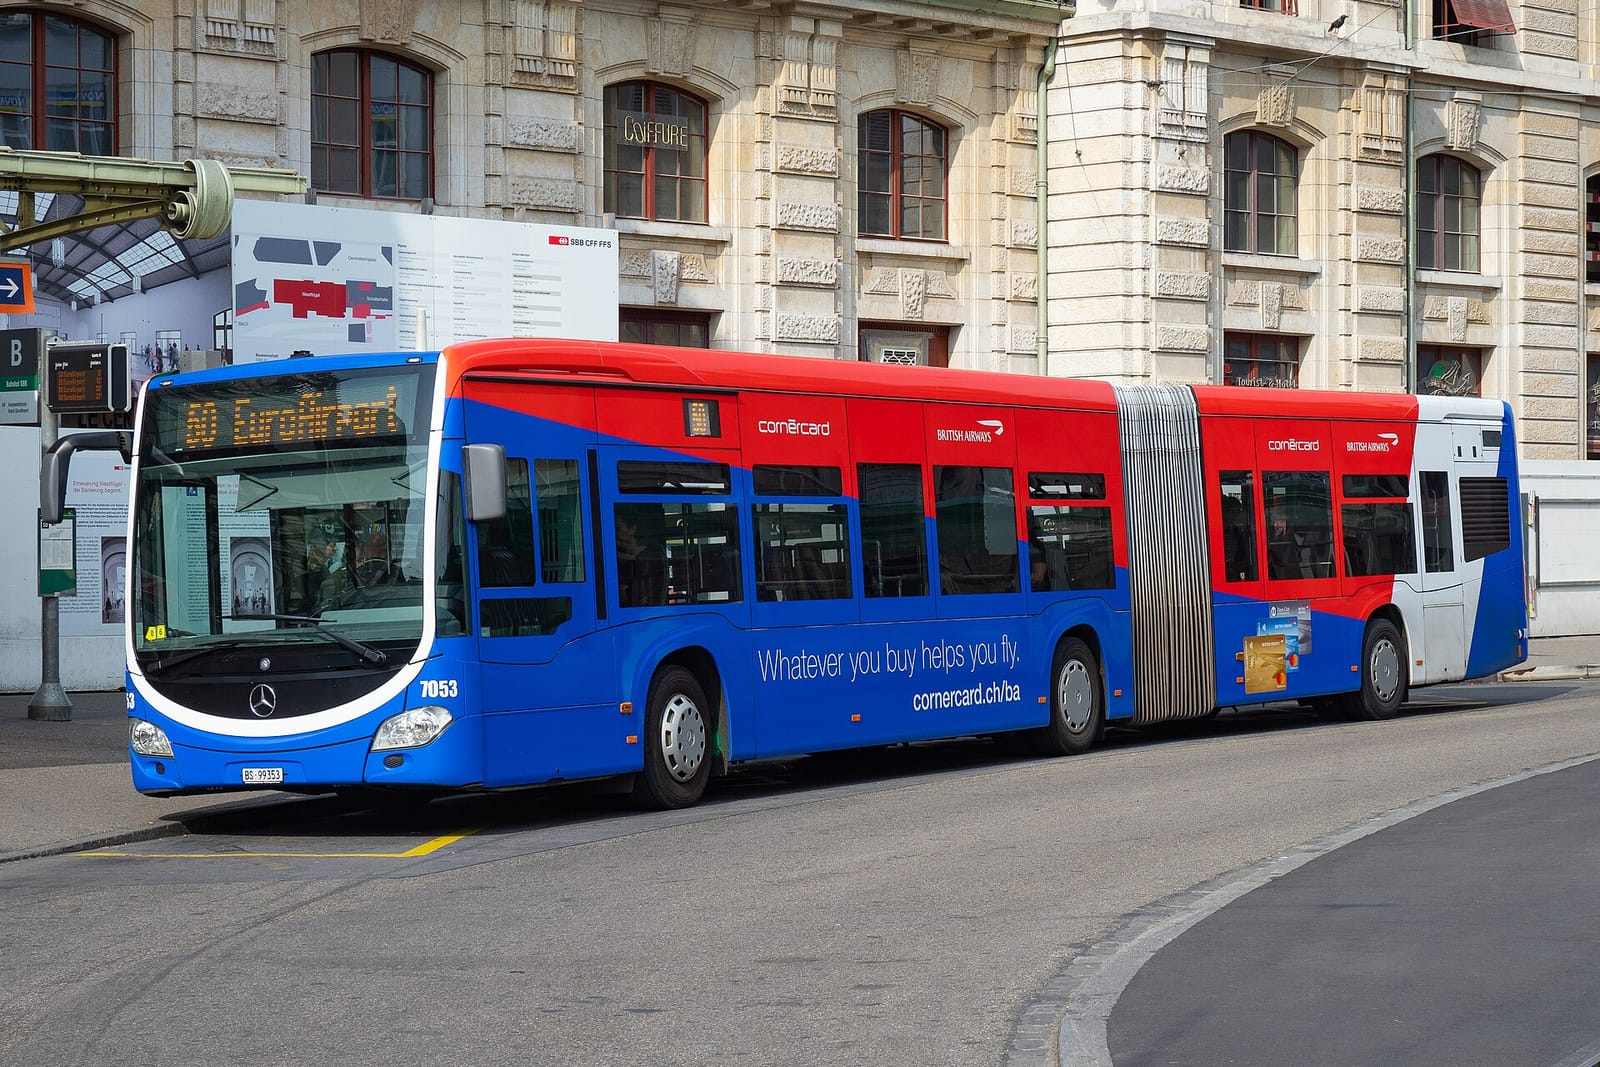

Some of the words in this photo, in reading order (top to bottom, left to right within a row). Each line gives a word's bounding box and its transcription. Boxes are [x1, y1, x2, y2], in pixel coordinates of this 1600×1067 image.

[570, 238, 584, 246] SBB
[585, 239, 597, 247] CFF
[599, 240, 612, 249] FFS
[11, 339, 22, 367] B
[936, 429, 964, 441] BRITISH
[964, 430, 992, 443] AIRWAYS
[1346, 441, 1367, 452] BRITISH
[1367, 442, 1390, 452] AIRWAYS
[758, 649, 844, 682] Whatever
[849, 651, 880, 682] you
[886, 642, 916, 678] buy
[921, 638, 964, 675] helps
[969, 642, 996, 672] you
[1001, 634, 1020, 669] fly.
[420, 680, 458, 698] 7053
[913, 680, 1021, 711] cornercard.ch/ba
